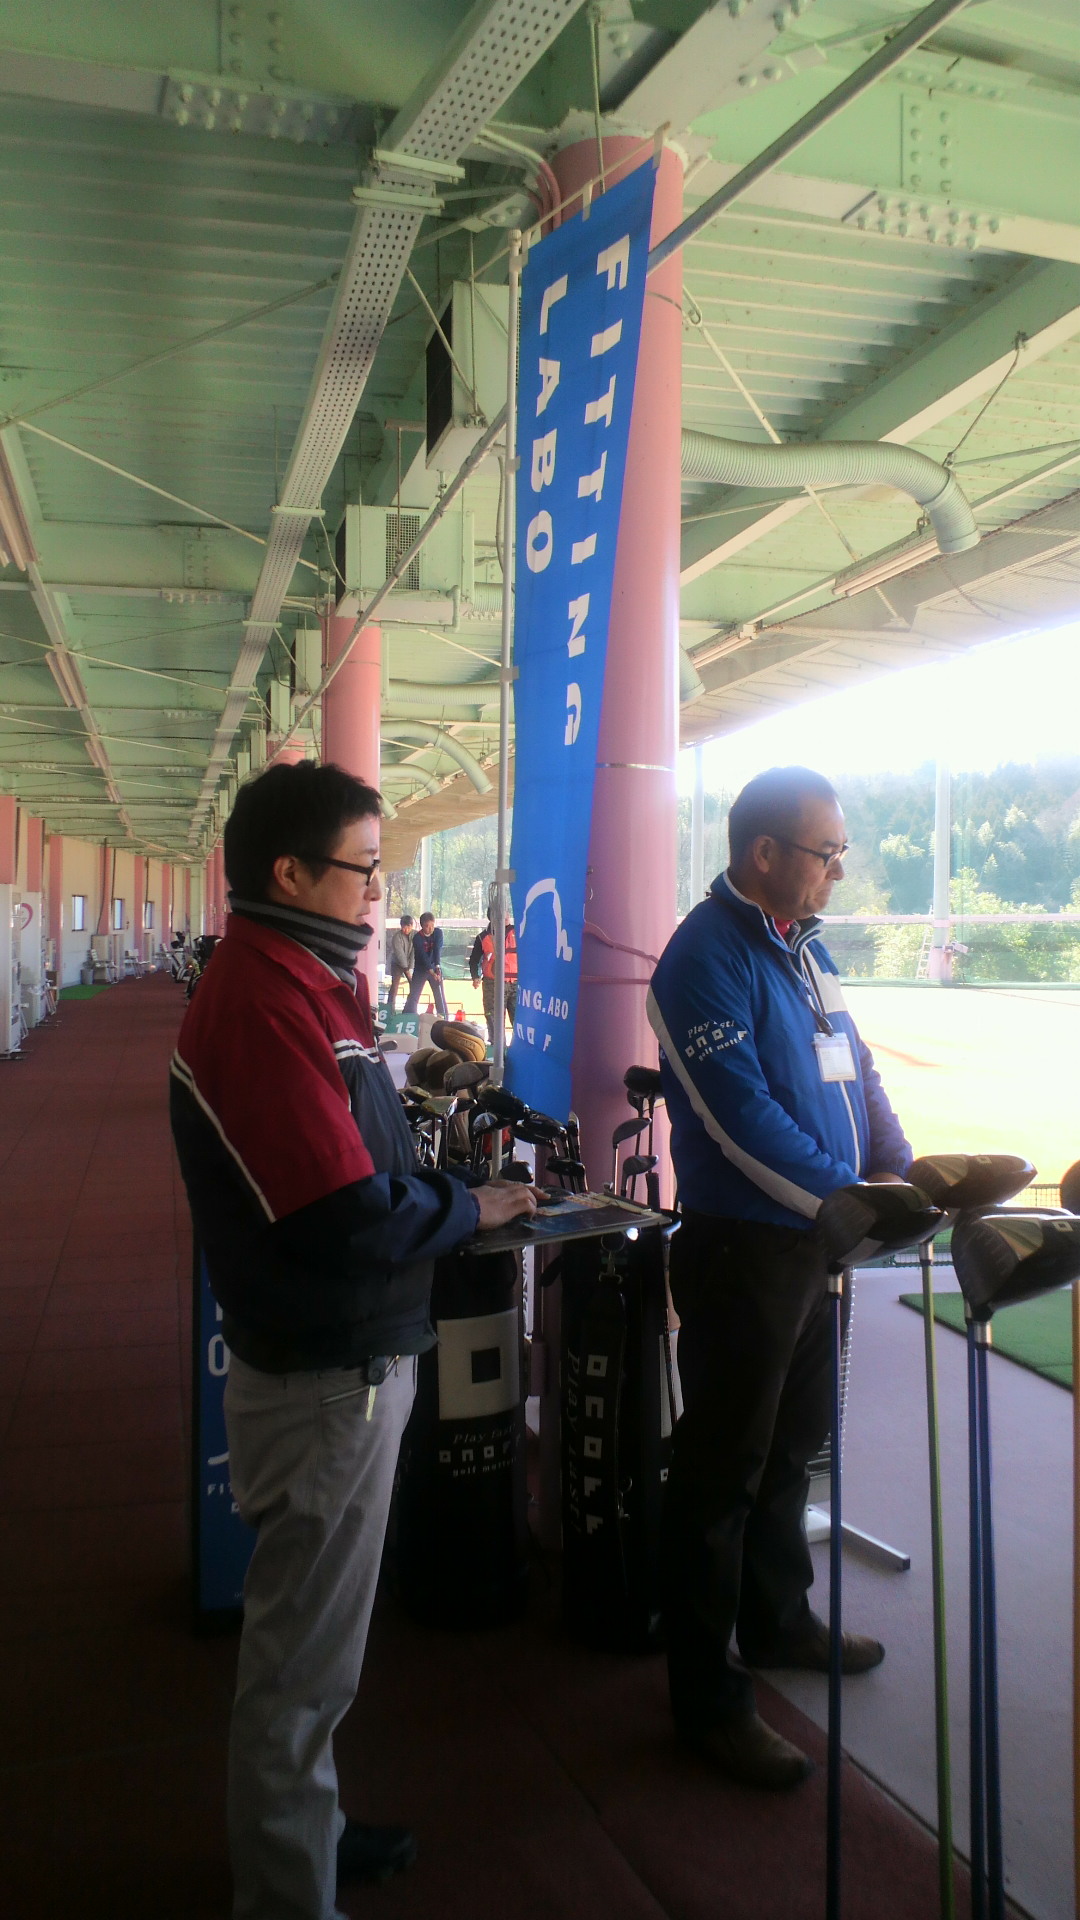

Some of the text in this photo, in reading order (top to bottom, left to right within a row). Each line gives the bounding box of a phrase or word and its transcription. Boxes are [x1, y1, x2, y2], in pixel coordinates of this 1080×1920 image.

[526, 274, 568, 574] LABO
[565, 234, 630, 746] FITTING
[395, 1021, 416, 1034] 15
